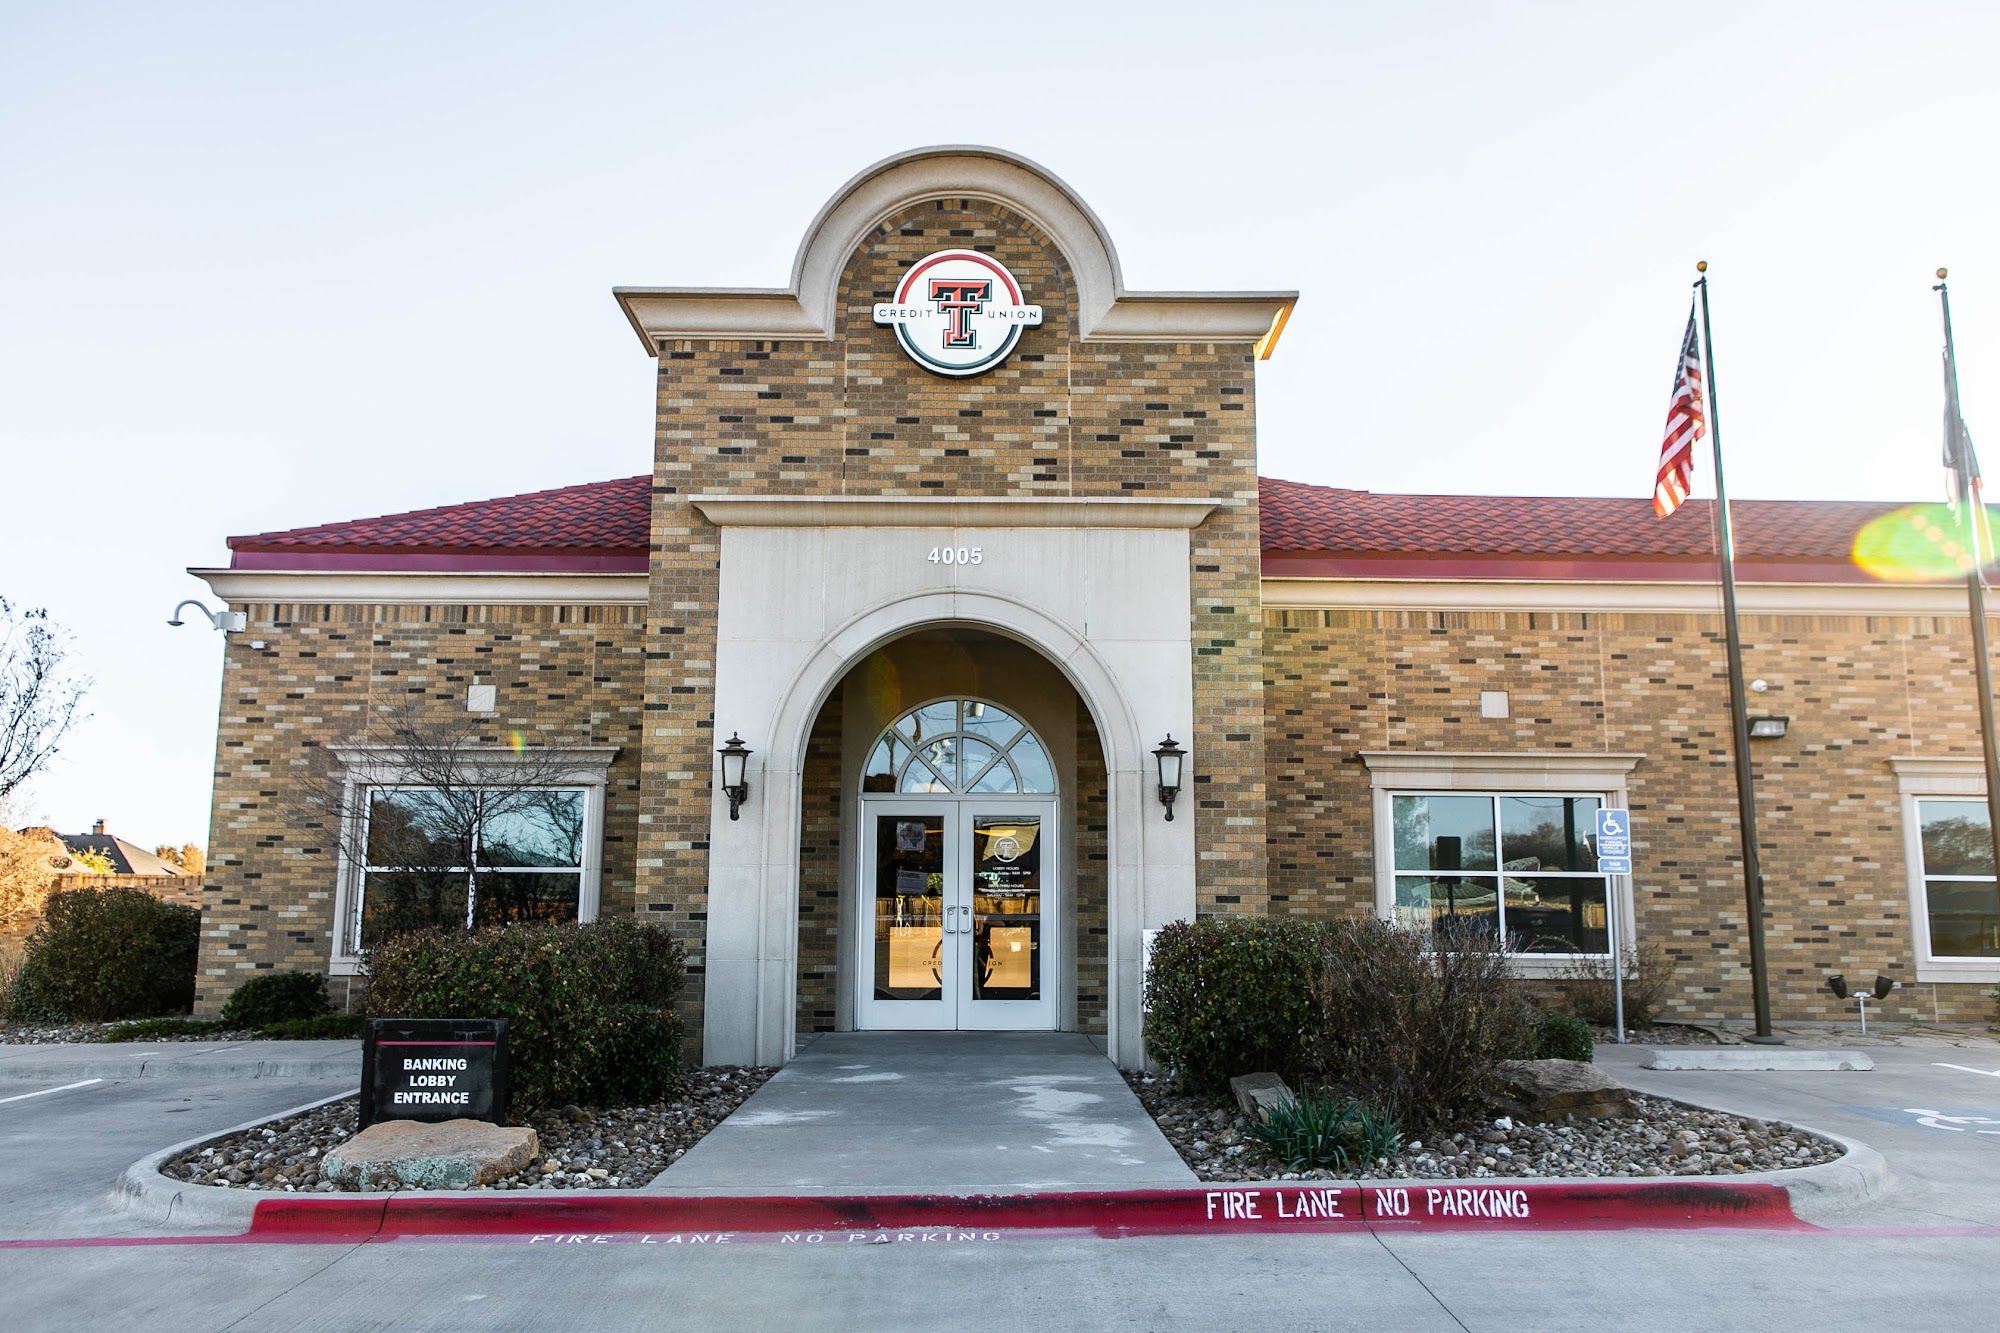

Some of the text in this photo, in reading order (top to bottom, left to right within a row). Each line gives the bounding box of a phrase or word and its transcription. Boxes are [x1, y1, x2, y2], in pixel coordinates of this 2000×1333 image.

[878, 308, 1037, 319] CREDIT UNION
[927, 547, 983, 565] 4005
[403, 1059, 467, 1070] BANKING
[409, 1075, 456, 1087] LOBBY
[394, 1092, 469, 1104] ENTRANCE
[1206, 1188, 1529, 1219] FIRE LANE NO PARKING
[528, 1232, 1000, 1244] FIRE LANE NO PARKING
